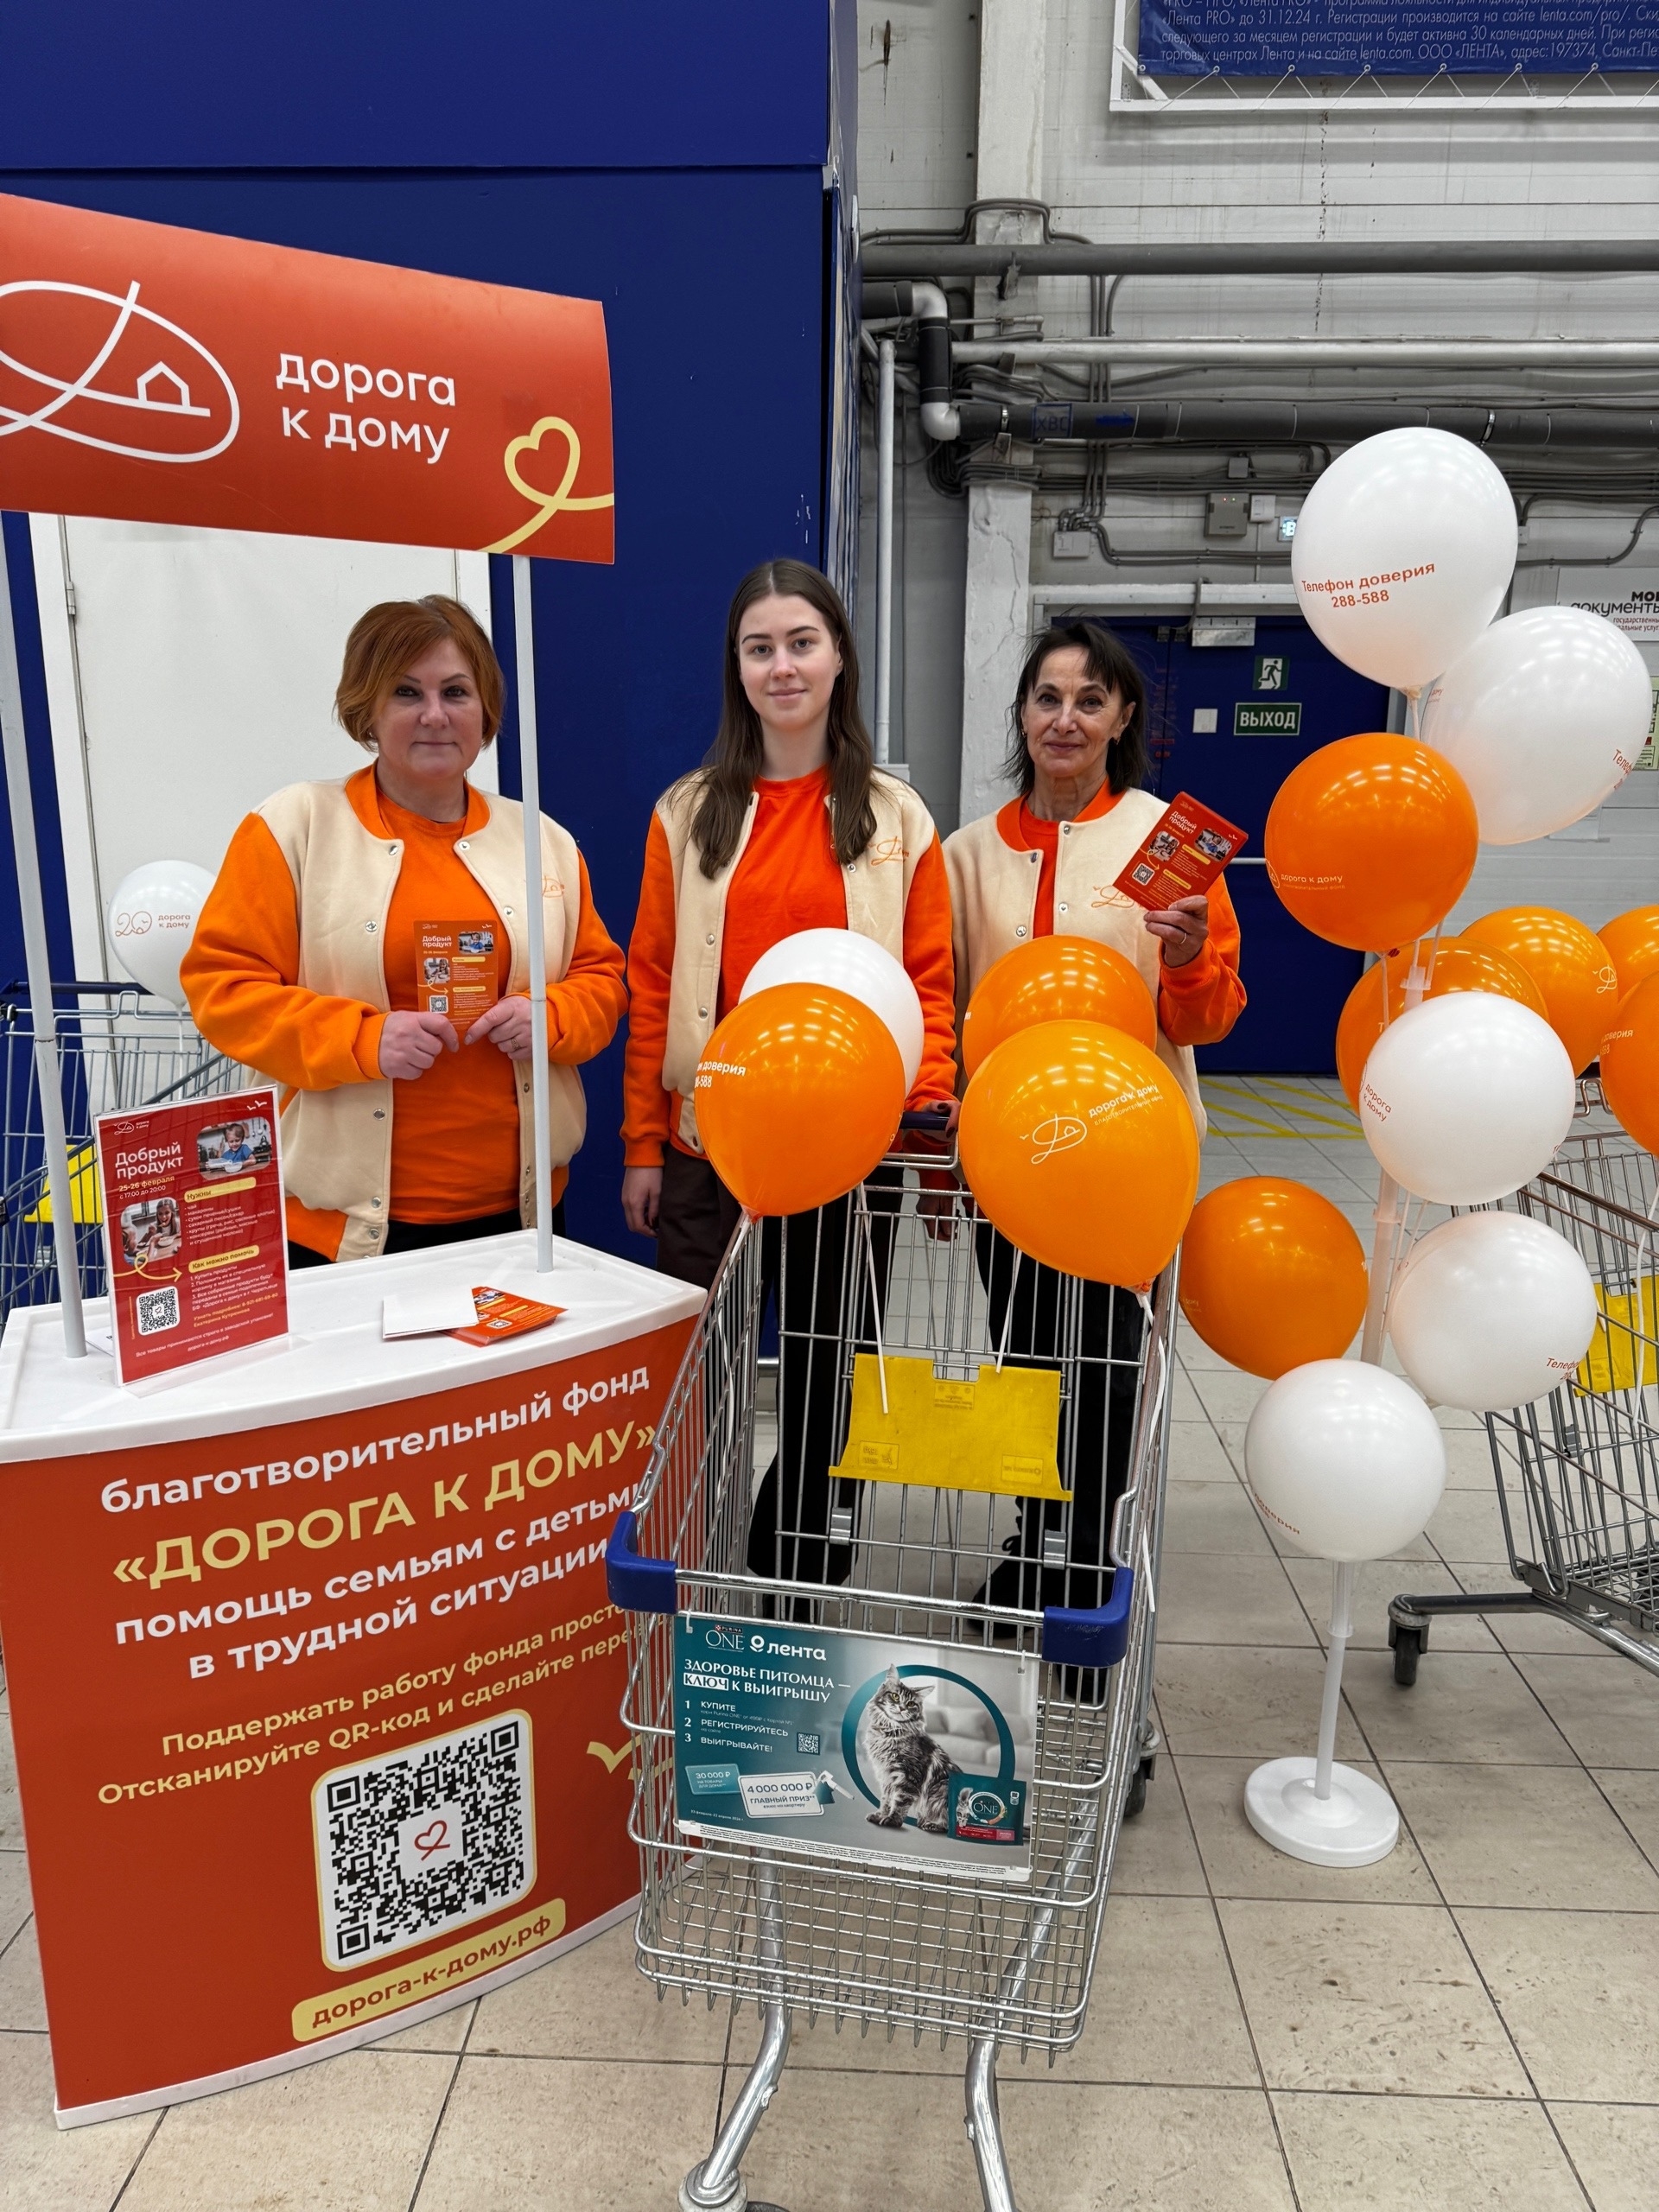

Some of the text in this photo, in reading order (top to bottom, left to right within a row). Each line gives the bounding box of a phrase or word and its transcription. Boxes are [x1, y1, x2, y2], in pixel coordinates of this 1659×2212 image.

[1162, 10, 1201, 25] «Лента
[1205, 10, 1235, 24] PRO»
[1239, 13, 1253, 26] до
[1258, 10, 1310, 24] 31.12.24
[1315, 15, 1323, 24] г.
[1328, 9, 1397, 27] Регистрации
[1402, 12, 1479, 27] производится
[1484, 12, 1498, 22] на
[1503, 9, 1535, 22] сайте
[1162, 33, 1229, 46] следующего
[1233, 33, 1246, 42] за
[1250, 32, 1297, 43] месяцем
[1301, 31, 1371, 46] регистрации
[1376, 31, 1382, 41] и
[1387, 27, 1418, 44] будет
[1422, 30, 1466, 41] активна
[1471, 25, 1487, 40] 30
[1491, 29, 1563, 43] календарных
[1567, 27, 1597, 41] дней.
[1601, 24, 1625, 42] При
[1161, 49, 1210, 64] торговых
[1213, 50, 1257, 64] центрах
[1260, 46, 1294, 60] Лента
[1298, 50, 1305, 60] и
[1307, 50, 1321, 60] на
[1325, 48, 1357, 60] сайте
[1360, 44, 1414, 60] lenta.com.
[1418, 44, 1452, 59] ООО
[1455, 43, 1507, 59] «ЛЕНТА»,
[276, 353, 456, 407] дорога
[282, 407, 450, 465] к дому
[1301, 563, 1435, 594] Телефон доверия
[1332, 589, 1389, 607] 288-588
[1240, 711, 1296, 729] ВЫХОД
[1168, 817, 1194, 835] продукт
[1171, 810, 1198, 830] Добрый
[702, 1061, 747, 1077] доверия
[1089, 1095, 1128, 1118] дорога
[1137, 1084, 1160, 1098] дому
[1365, 1084, 1392, 1113] дорога
[1367, 1100, 1387, 1122] дому
[114, 1141, 181, 1168] Добрый
[117, 1156, 183, 1181] продукт
[118, 1174, 175, 1192] 25-26 февраля
[188, 1189, 212, 1201] Нужны
[192, 1249, 253, 1269] Как можно помочь
[213, 1265, 237, 1275] продукты
[101, 1366, 650, 1513] благотворительный фонд
[113, 1421, 656, 1590] «ДОРОГА К ДОМУ»
[116, 1587, 312, 1644] помощь
[324, 1538, 483, 1599] семьям
[495, 1529, 517, 1551] с
[189, 1538, 607, 1679] в трудной ситуации
[705, 1630, 746, 1650] ONE
[766, 1643, 827, 1661] лента
[684, 1659, 835, 1689] ЗДОРОВЬЕ ПИТОМЦА
[162, 1697, 354, 1755] Поддержать
[362, 1662, 456, 1709] работу
[462, 1633, 543, 1676] фонда
[685, 1674, 830, 1703] КЛЮЧ К ВЫИГРЫШУ
[685, 1700, 736, 1712] 1 КУПИТЕ
[98, 1739, 321, 1804] Отсканируйте
[328, 1706, 430, 1749] QR-код
[438, 1698, 454, 1719] и
[461, 1656, 575, 1712] сделайте
[685, 1718, 789, 1737] 2 РЕГИСТРИРУЙТЕСЬ
[685, 1733, 772, 1752] 3 ВЫИГРЫВАЙТЕ!
[756, 1784, 779, 1793] 000
[973, 1802, 999, 1815] ONE
[312, 1915, 551, 2029] дорога-к-дому.рф
